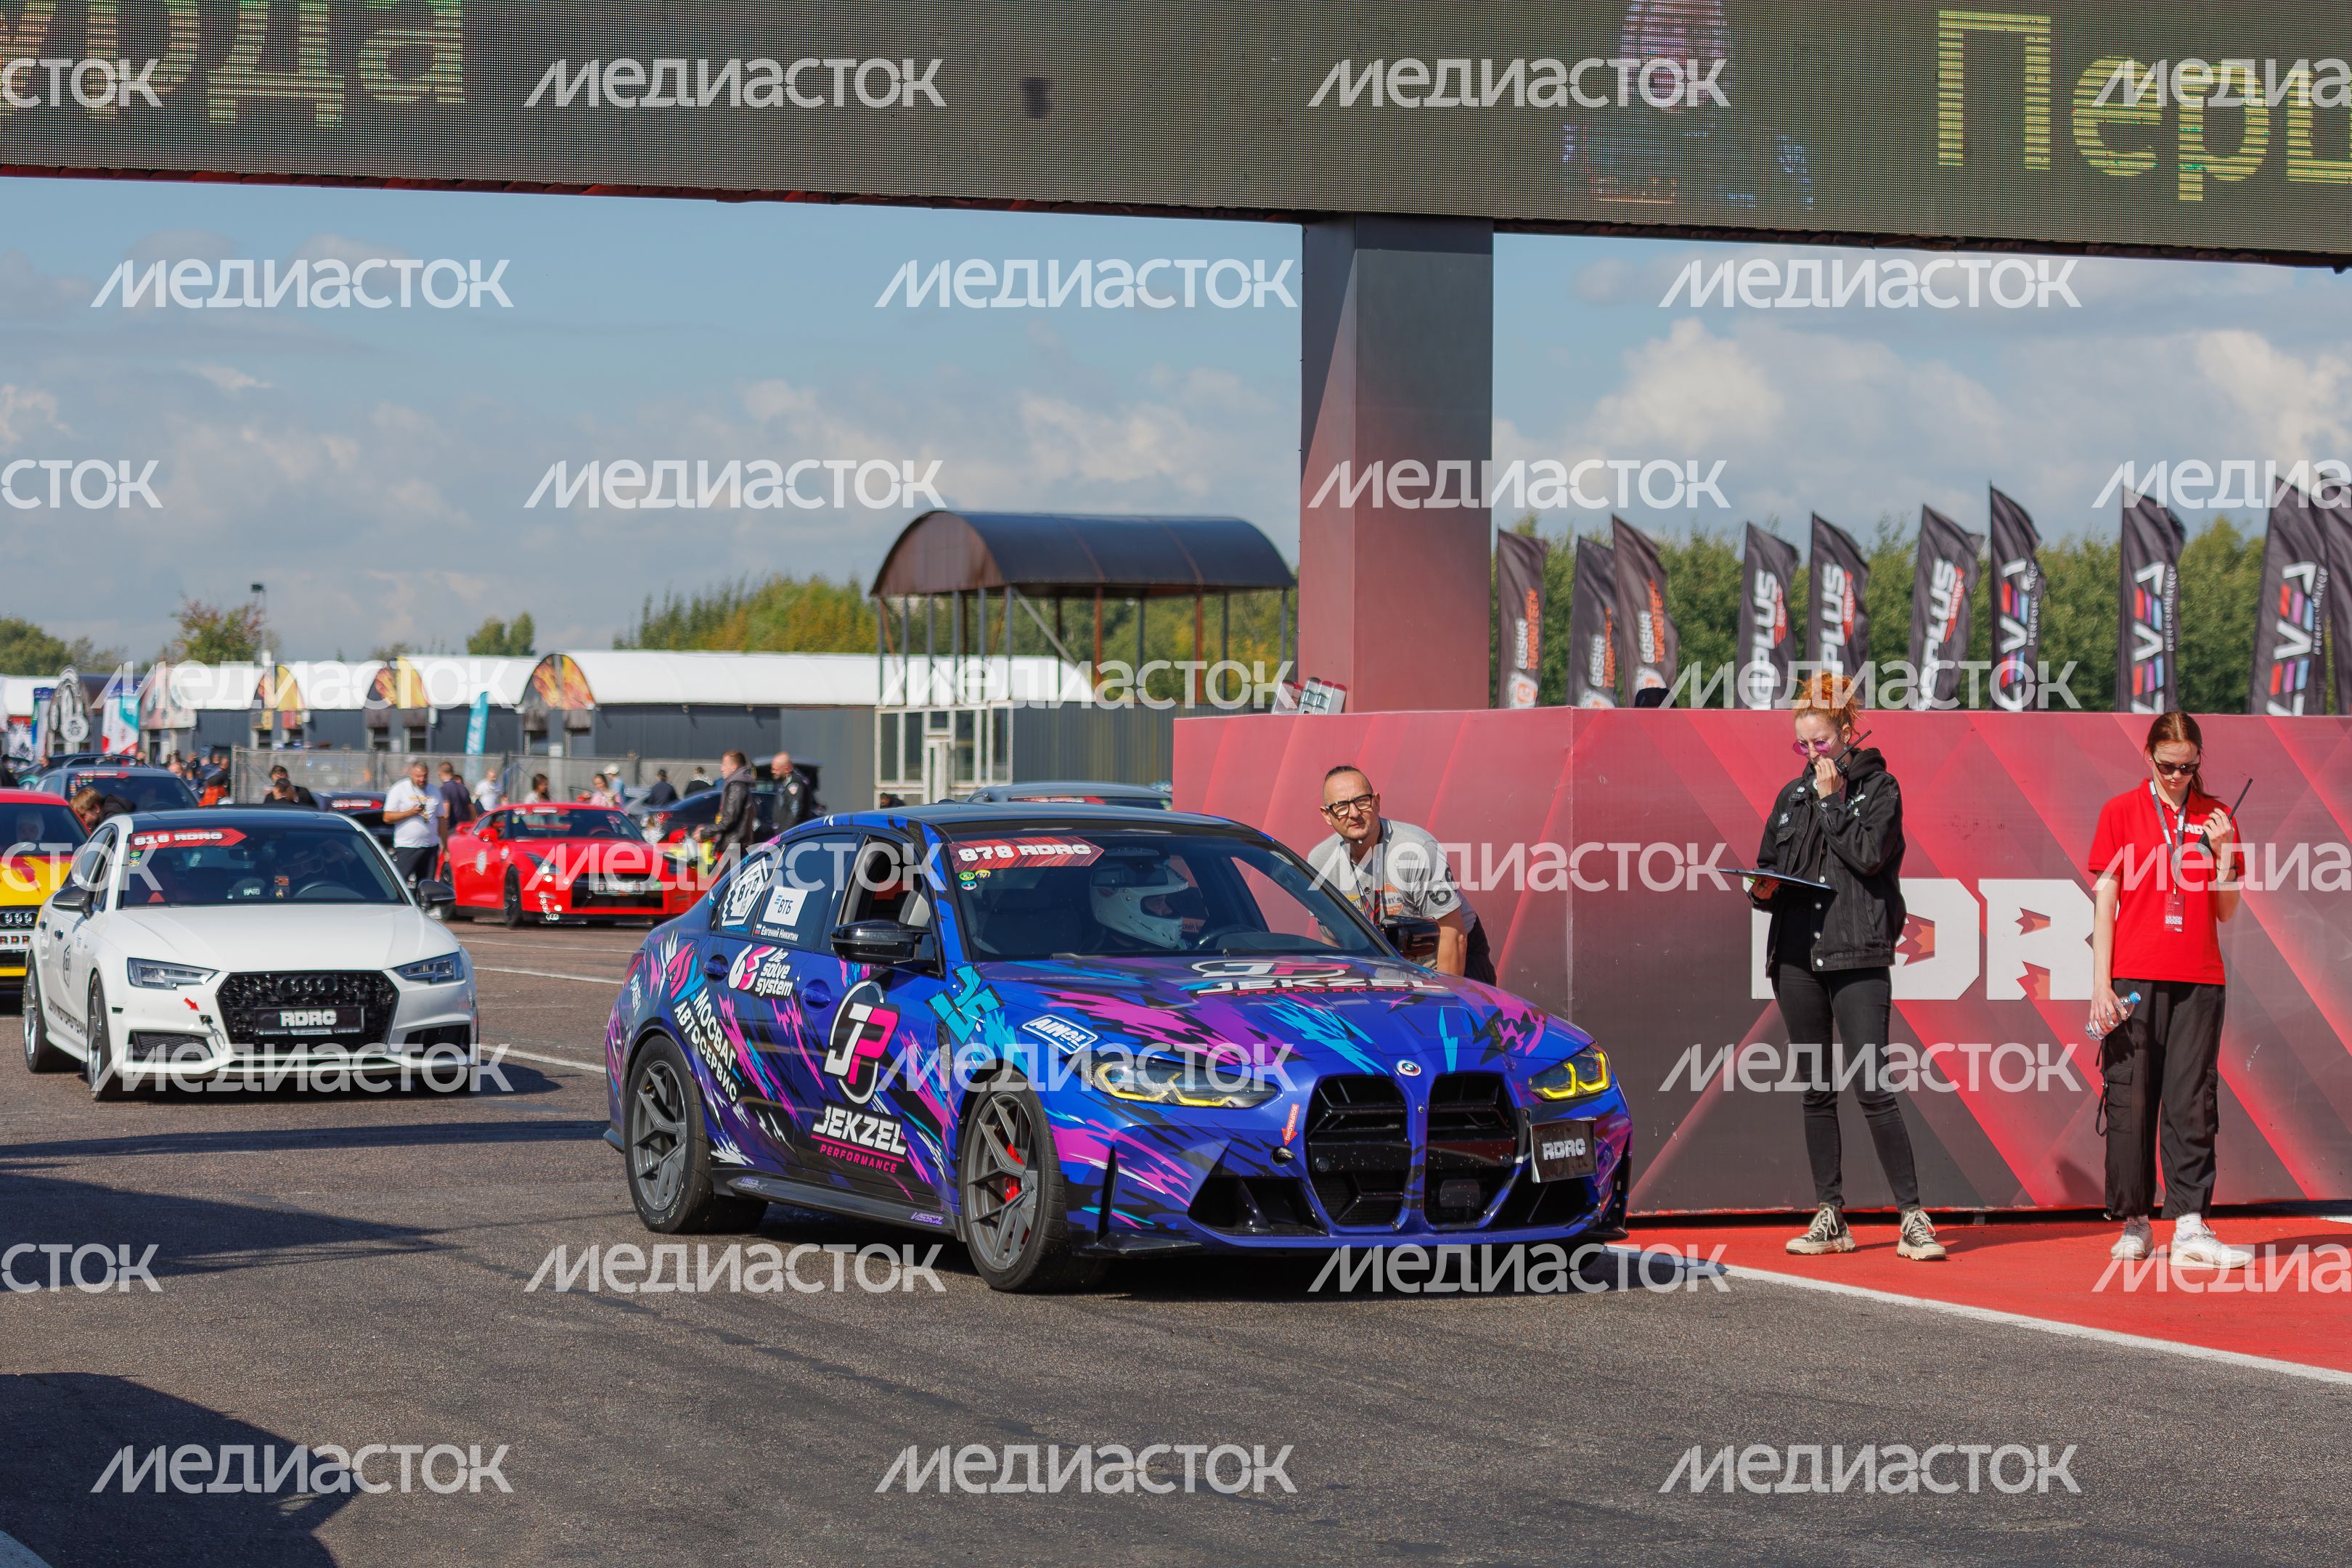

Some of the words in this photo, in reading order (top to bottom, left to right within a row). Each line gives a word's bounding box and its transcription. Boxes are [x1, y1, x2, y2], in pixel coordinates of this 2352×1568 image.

[957, 844, 1015, 862] 878
[1016, 844, 1092, 856] RDRC
[768, 947, 789, 963] be
[760, 962, 791, 980] solve
[755, 977, 793, 997] system
[1197, 977, 1449, 995] JEKZEL
[279, 1009, 338, 1027] RDRC
[693, 987, 737, 1071] МОСВАГ
[674, 1000, 738, 1102] АВТОСЕРВИС
[812, 1106, 907, 1156] JEKZEL
[820, 1143, 897, 1174] PERFORMANCE
[1542, 1138, 1586, 1161] RDRC
